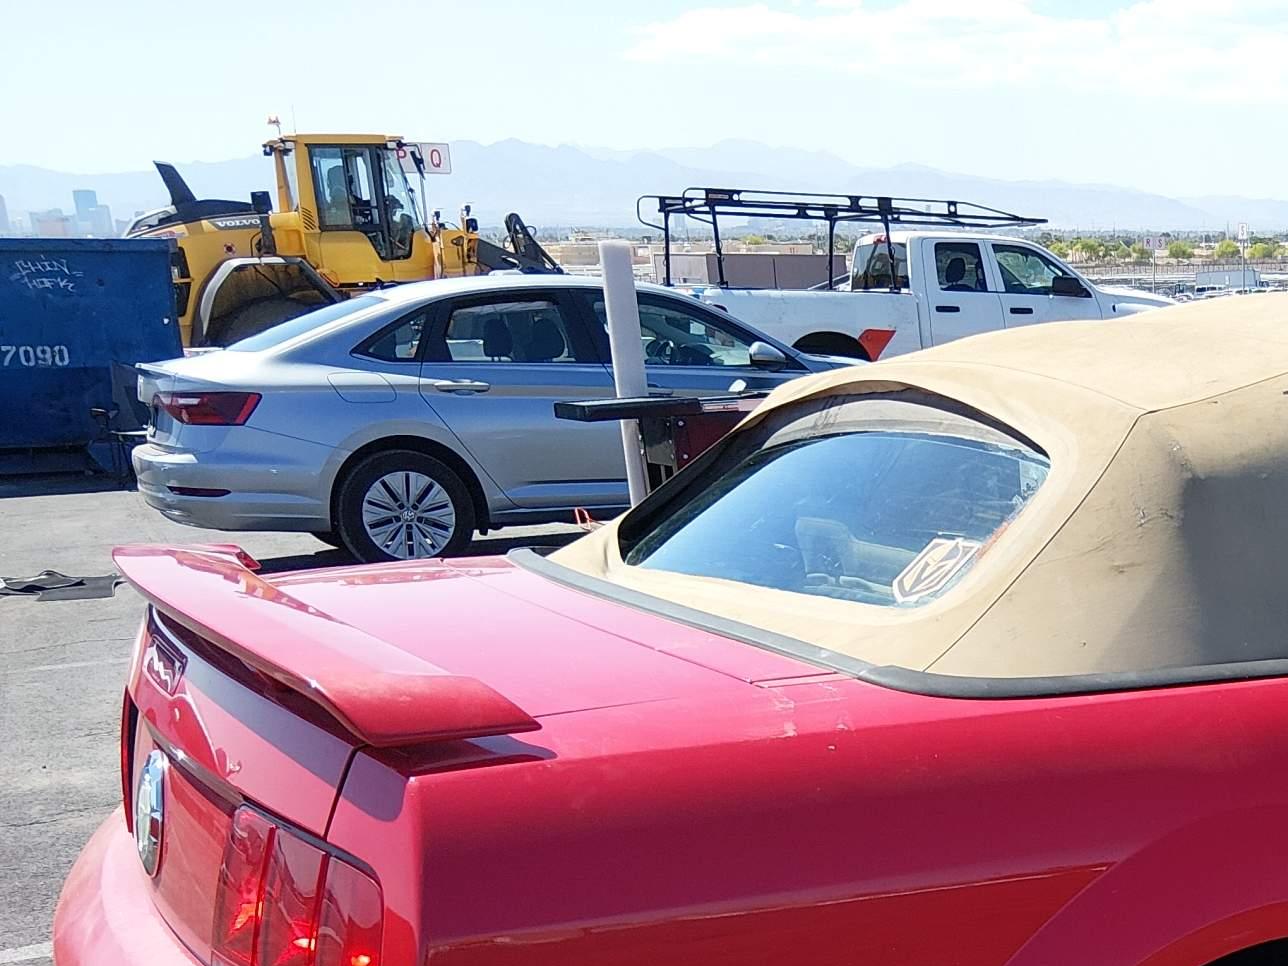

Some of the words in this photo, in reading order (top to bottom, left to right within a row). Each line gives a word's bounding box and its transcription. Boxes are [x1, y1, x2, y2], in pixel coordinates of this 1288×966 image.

[430, 149, 442, 168] Q
[216, 219, 260, 227] VOLVO
[1157, 238, 1163, 248] S
[1, 345, 70, 366] 7090
